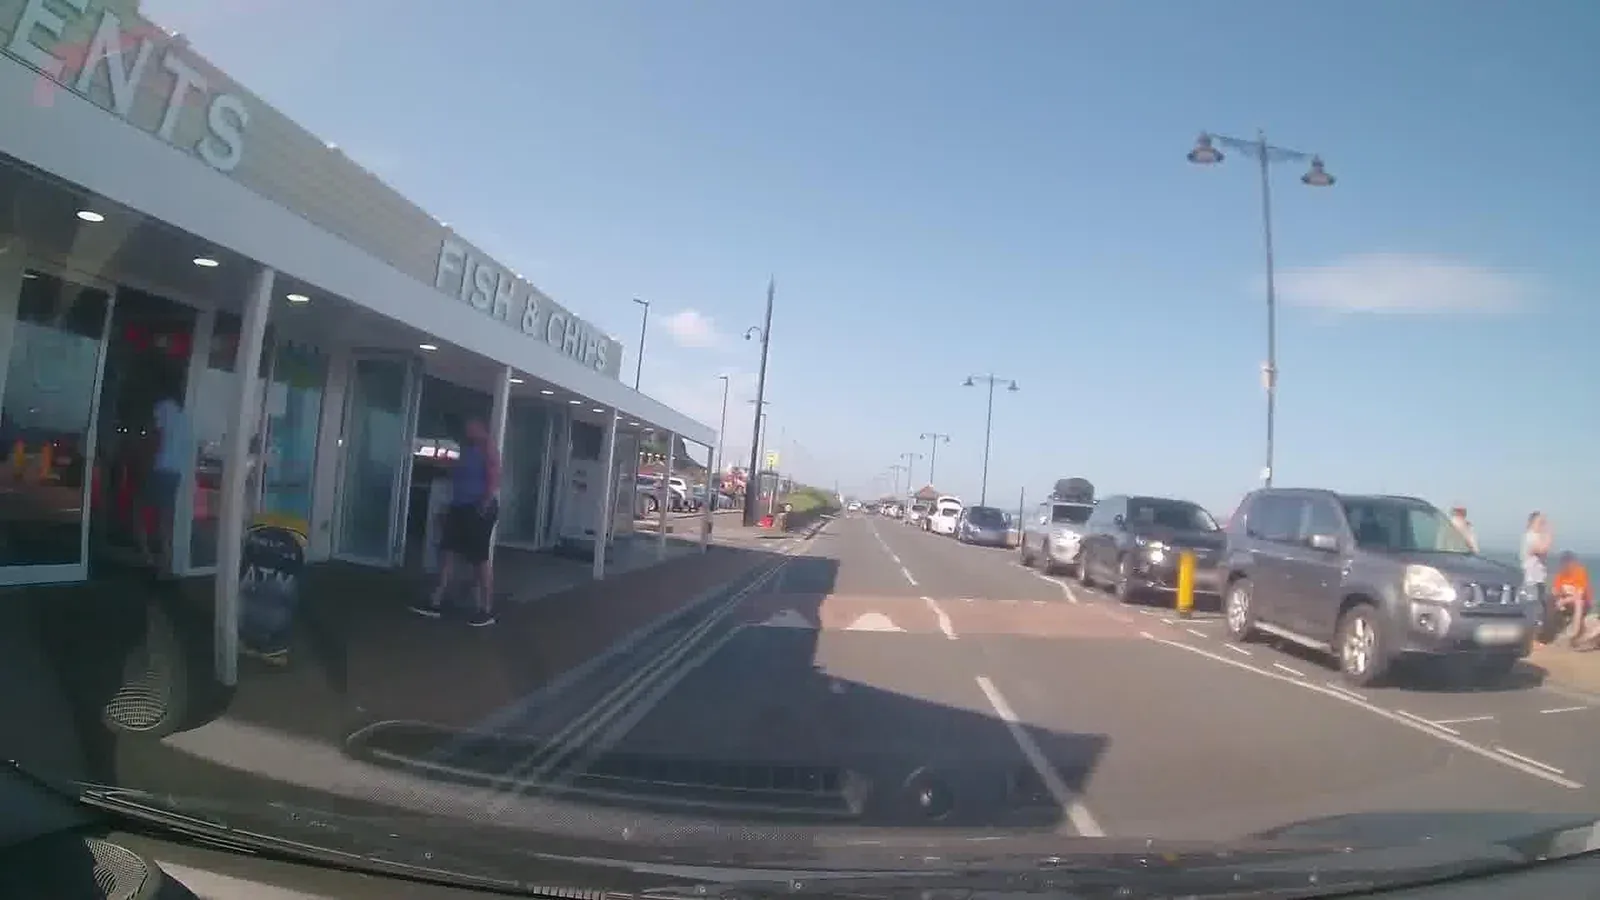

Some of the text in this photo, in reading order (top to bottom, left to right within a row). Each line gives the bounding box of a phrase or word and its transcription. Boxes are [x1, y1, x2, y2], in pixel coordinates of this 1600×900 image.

[7, 0, 249, 171] ENTS
[436, 239, 608, 371] FISH & CHIPS
